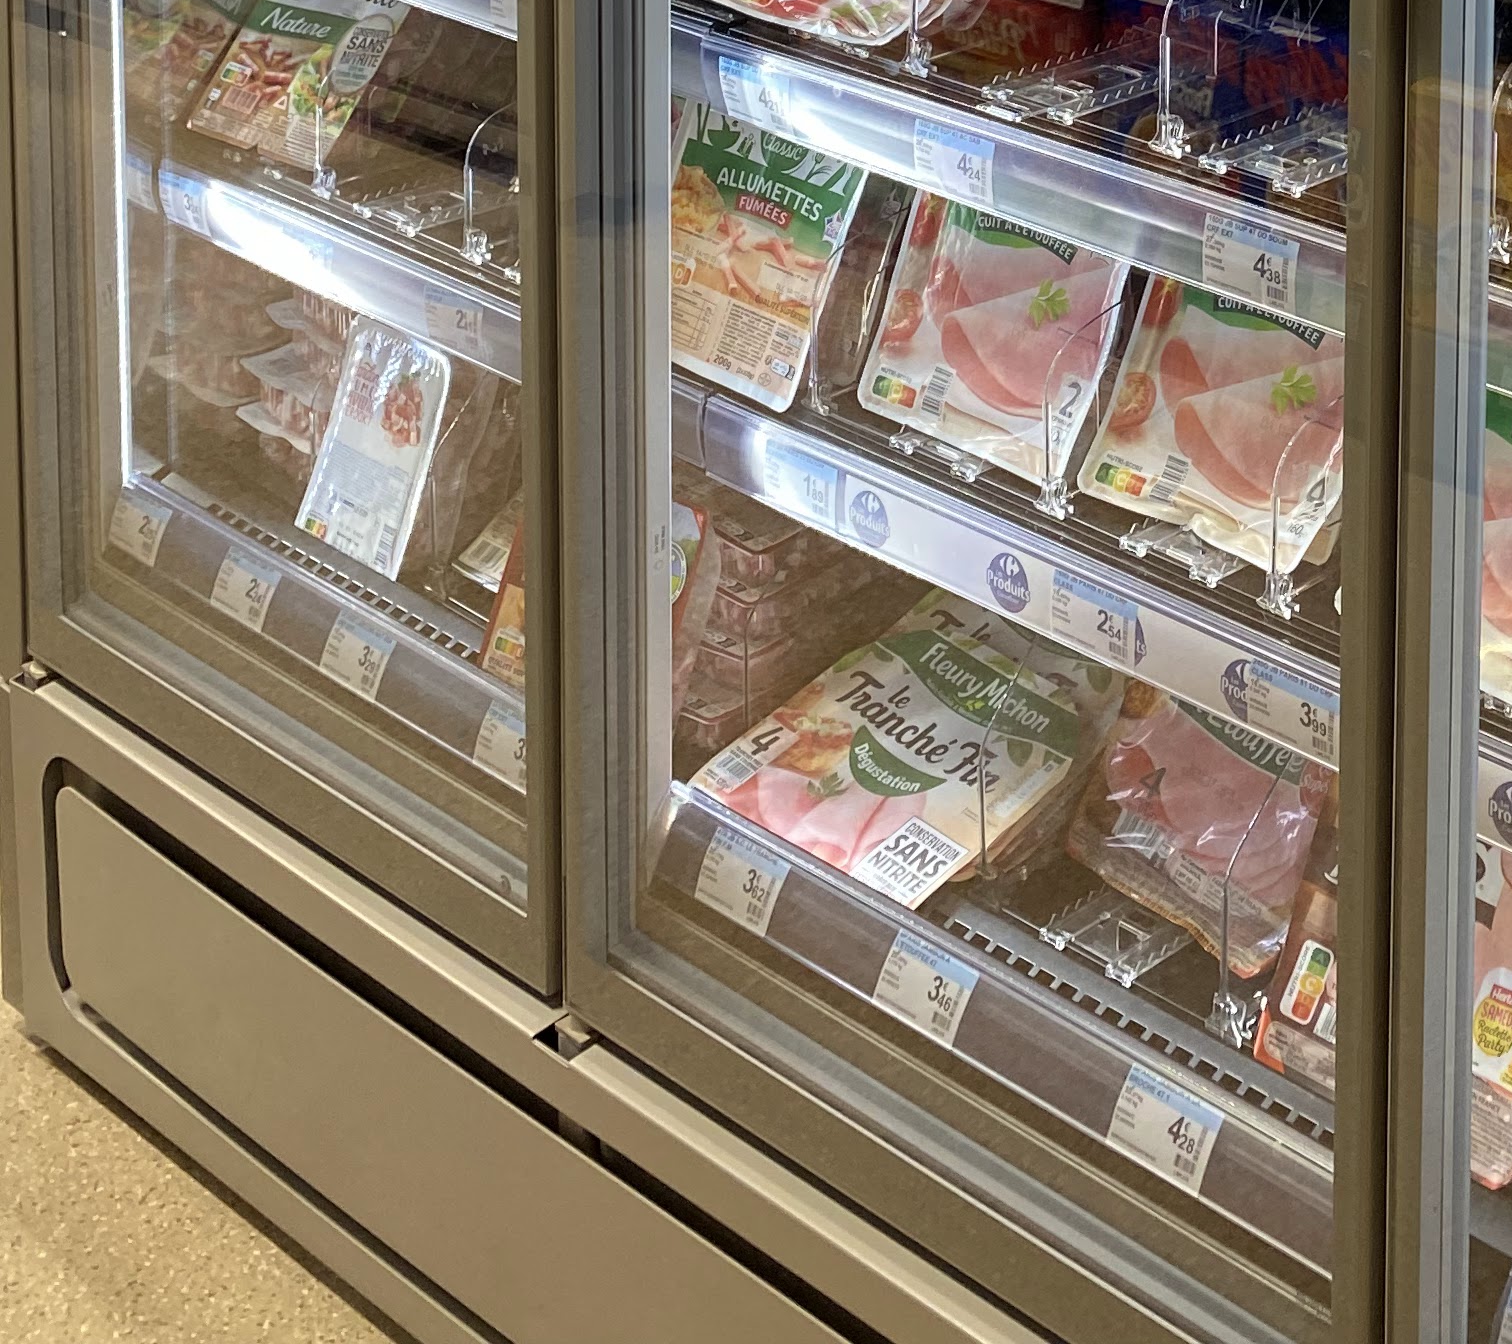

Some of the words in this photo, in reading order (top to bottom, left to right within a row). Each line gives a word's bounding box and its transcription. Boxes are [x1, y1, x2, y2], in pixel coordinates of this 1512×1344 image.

[260, 7, 332, 38] Nature
[347, 36, 386, 54] SANS
[716, 165, 824, 222] ALLUMETTES
[739, 196, 789, 226] FUMÉES
[919, 642, 984, 698] Fleury
[854, 742, 920, 794] Dégustation
[867, 852, 927, 894] NITRITE
[884, 834, 948, 880] SANS
